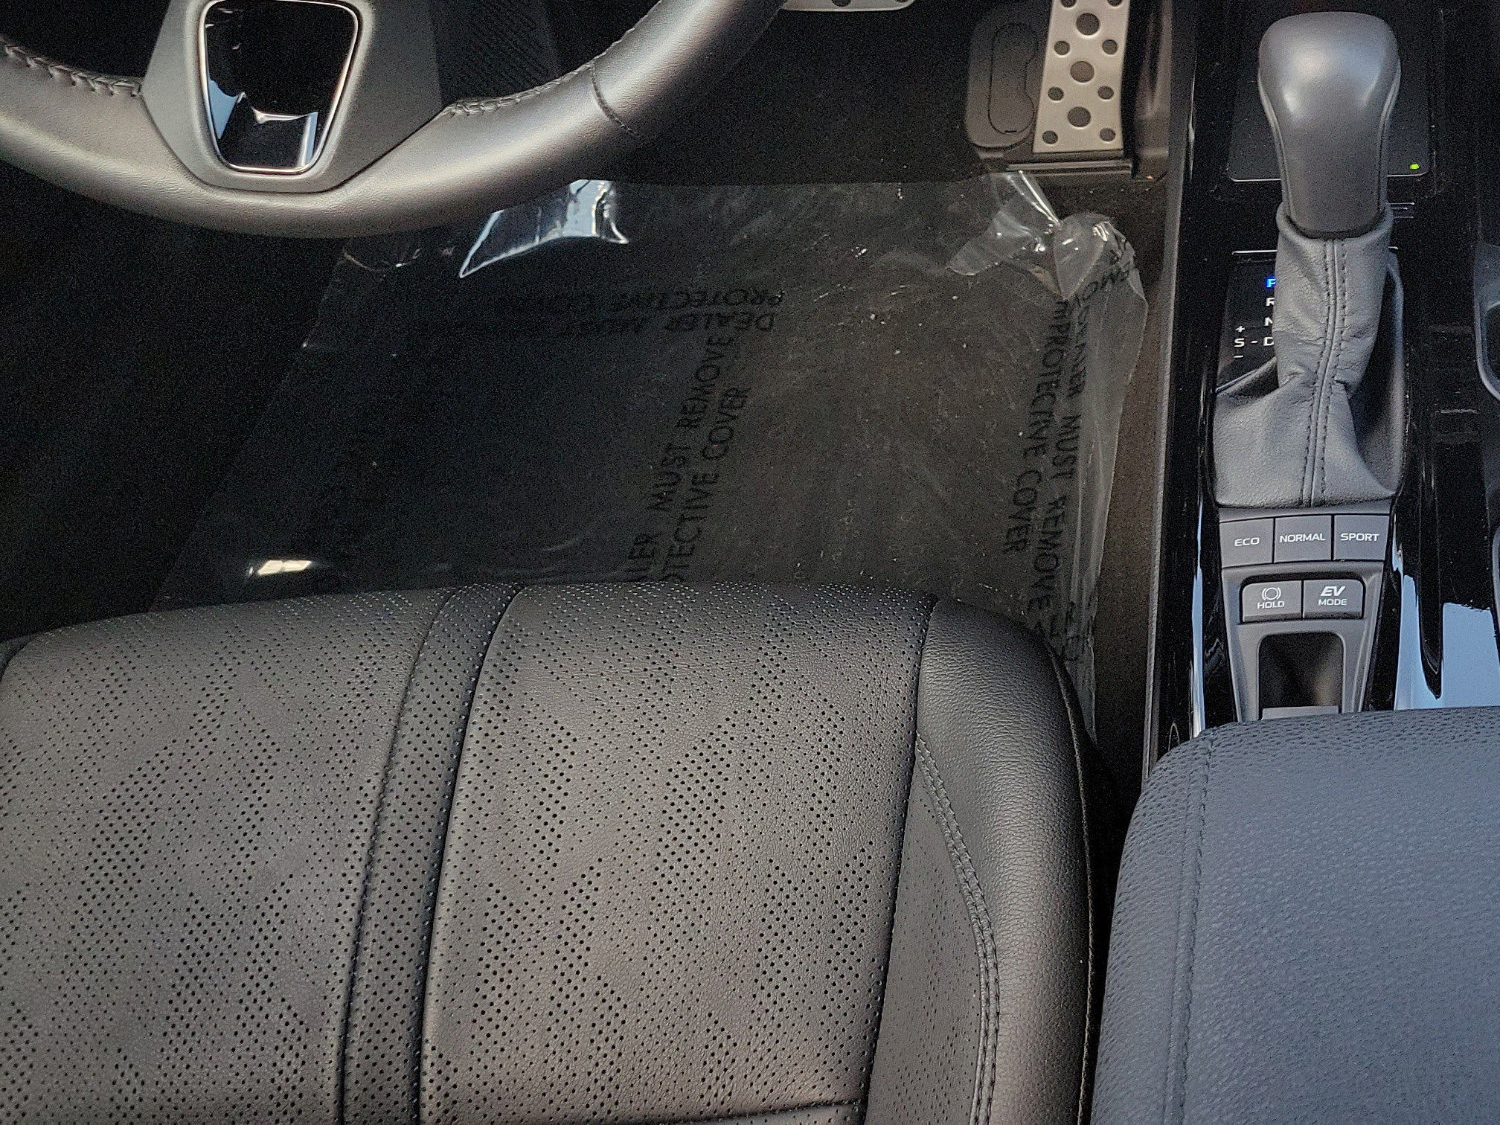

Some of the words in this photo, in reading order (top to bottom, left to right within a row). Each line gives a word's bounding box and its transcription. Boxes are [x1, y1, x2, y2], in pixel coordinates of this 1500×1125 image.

[1234, 337, 1245, 348] S
[1023, 322, 1071, 459] PROTECTIVE
[646, 442, 691, 512] MUST
[676, 336, 734, 429] REMOVE
[700, 387, 750, 460] COVER
[1051, 415, 1082, 479] MUST
[1003, 469, 1042, 554] COVER
[1234, 536, 1260, 547] ECO
[1279, 533, 1326, 543] NORMAL
[1340, 532, 1380, 542] SPORT
[1027, 495, 1068, 613] REMOVE
[1320, 585, 1346, 596] EV
[1257, 600, 1285, 609] HOLD
[1318, 598, 1348, 606] MODE
